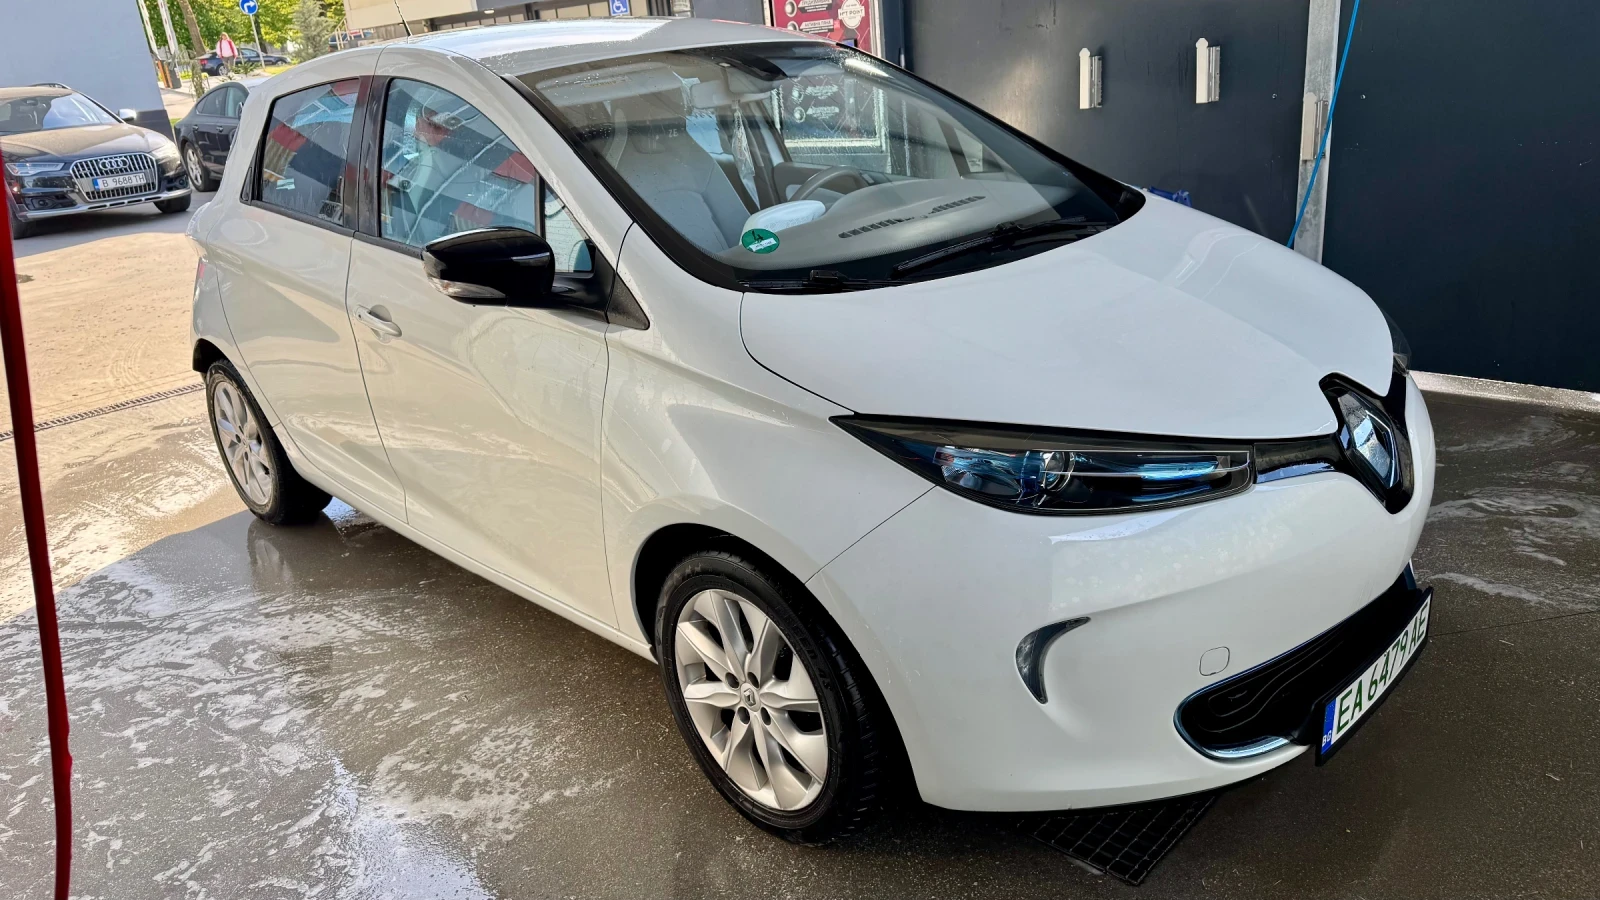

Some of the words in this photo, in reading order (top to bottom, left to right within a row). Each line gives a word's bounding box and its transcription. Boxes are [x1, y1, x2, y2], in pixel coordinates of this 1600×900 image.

[112, 177, 132, 186] 9688
[1336, 679, 1363, 735] EA
[1367, 629, 1409, 702] 6479
[1408, 602, 1429, 654] AE
[1321, 729, 1333, 747] BG
